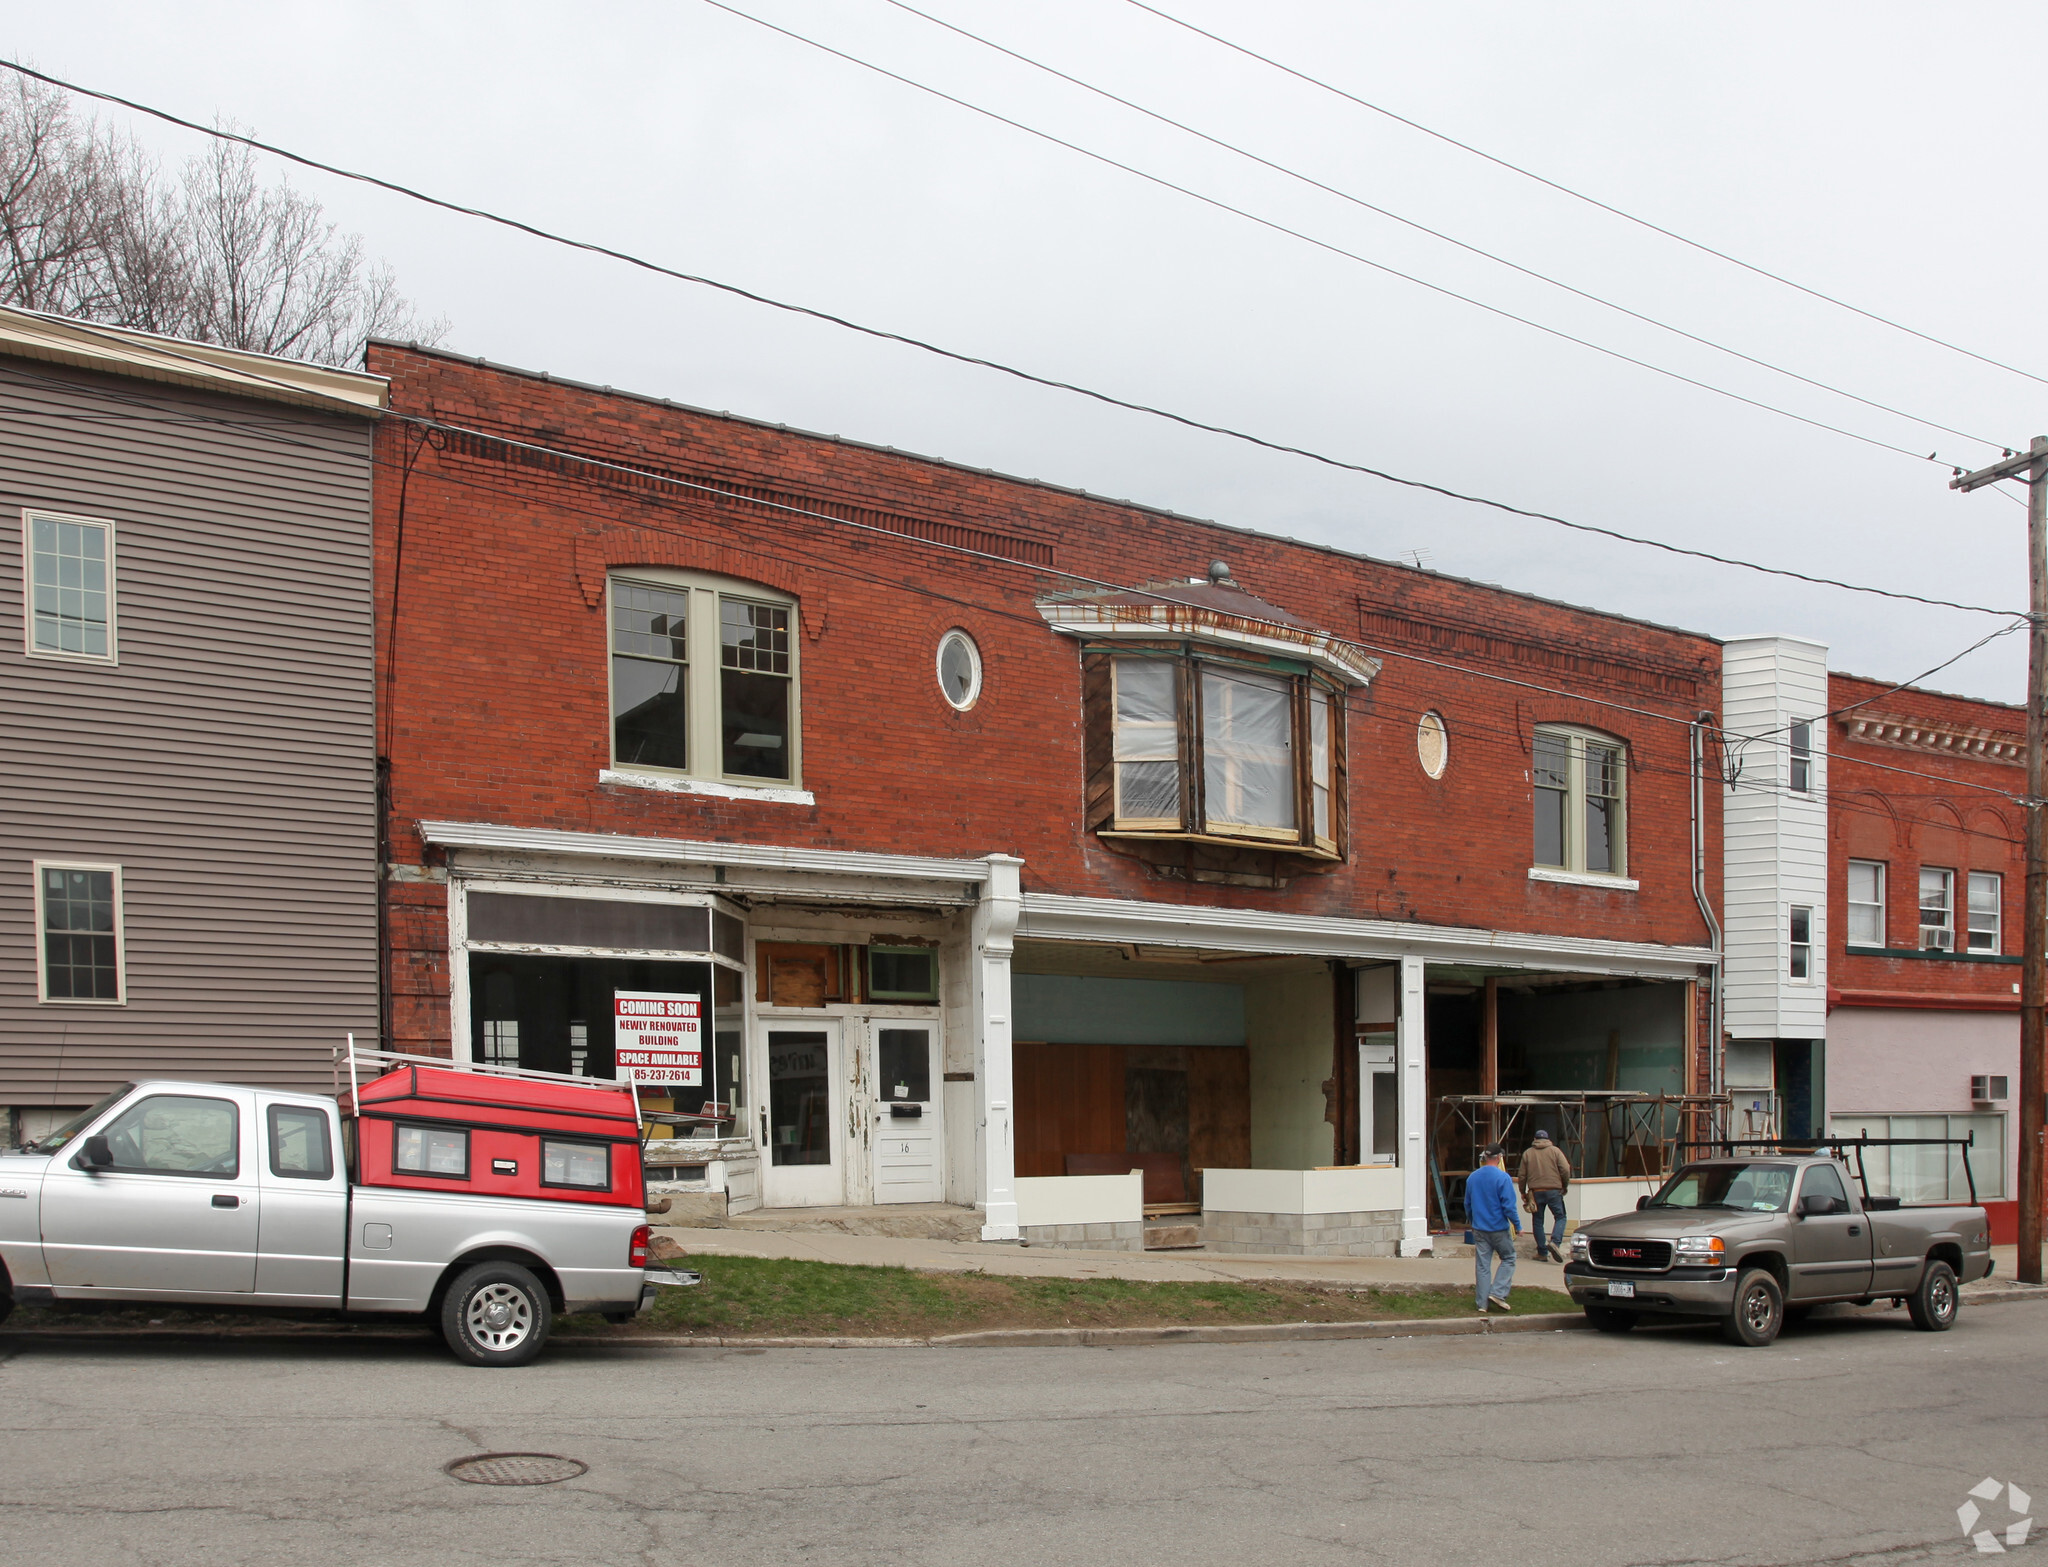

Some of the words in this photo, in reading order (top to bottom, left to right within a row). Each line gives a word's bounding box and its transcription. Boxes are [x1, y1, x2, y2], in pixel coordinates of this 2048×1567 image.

[620, 1001, 665, 1015] COMING
[667, 1002, 697, 1016] SOON
[620, 1020, 647, 1030] NEWLY
[650, 1021, 697, 1032] RENOVATED
[639, 1035, 678, 1046] BUILDING
[620, 1052, 649, 1064] SPACE
[651, 1054, 698, 1065] AVAILABLE
[629, 1069, 690, 1080] 85-237-2614
[901, 1143, 909, 1153] 16
[1613, 1248, 1641, 1258] GMC
